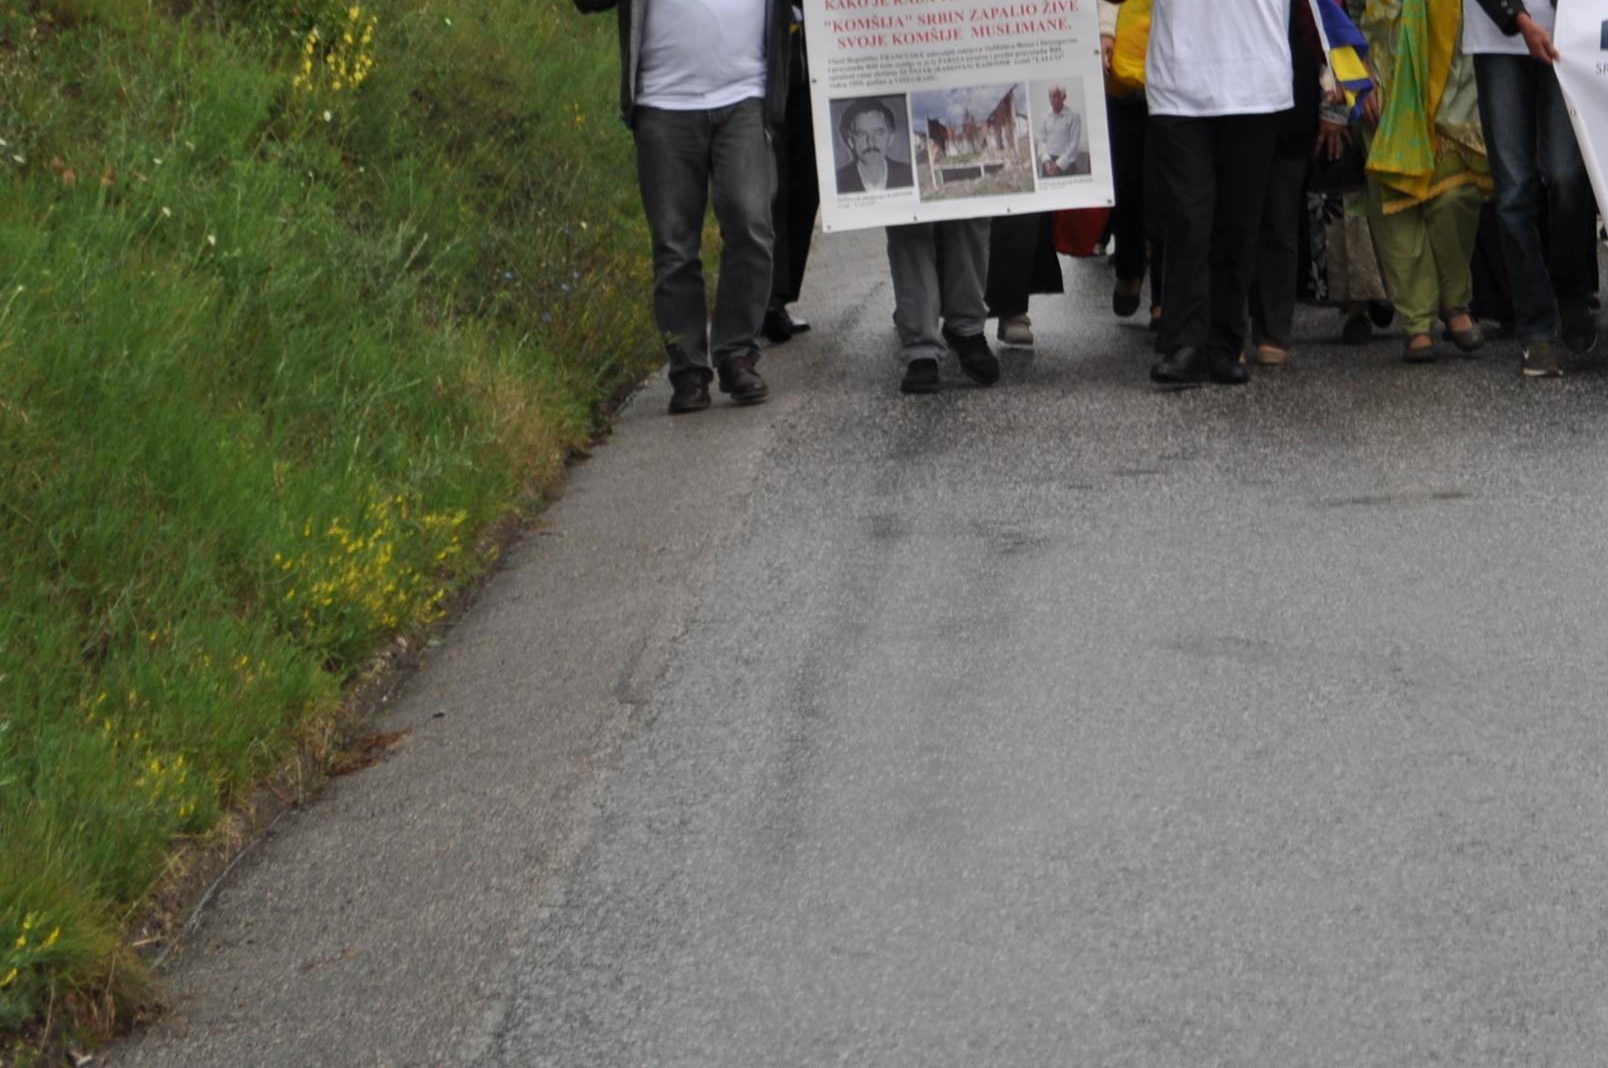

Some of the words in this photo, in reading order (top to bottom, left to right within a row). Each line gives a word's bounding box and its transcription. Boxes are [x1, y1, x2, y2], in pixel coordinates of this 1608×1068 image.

[824, 13, 913, 33] "KOMŠIJA"
[917, 11, 964, 27] SRBIN
[968, 2, 1038, 21] ZAPALIO
[837, 33, 888, 50] SVOJE
[892, 27, 962, 46] KOMŠIJE
[971, 17, 1072, 39] MUSLIMANE.
